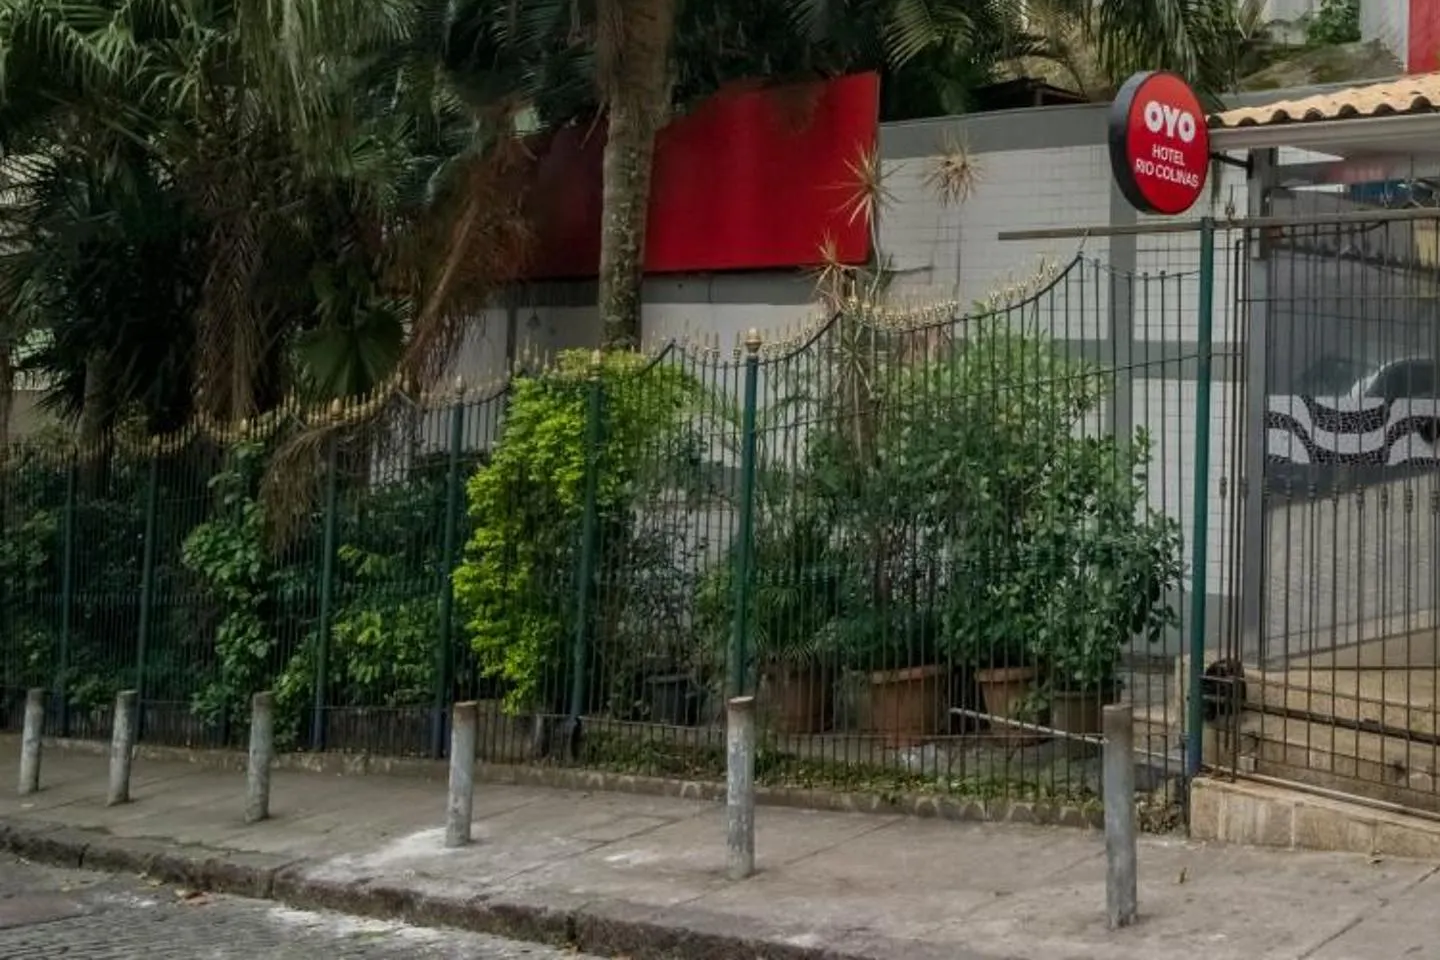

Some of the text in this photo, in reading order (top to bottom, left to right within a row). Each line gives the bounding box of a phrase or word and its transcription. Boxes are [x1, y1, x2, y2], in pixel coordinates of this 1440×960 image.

[1144, 101, 1196, 143] OYO
[1151, 143, 1185, 166] HOTEL
[1135, 158, 1199, 188] RIO COLINAS
